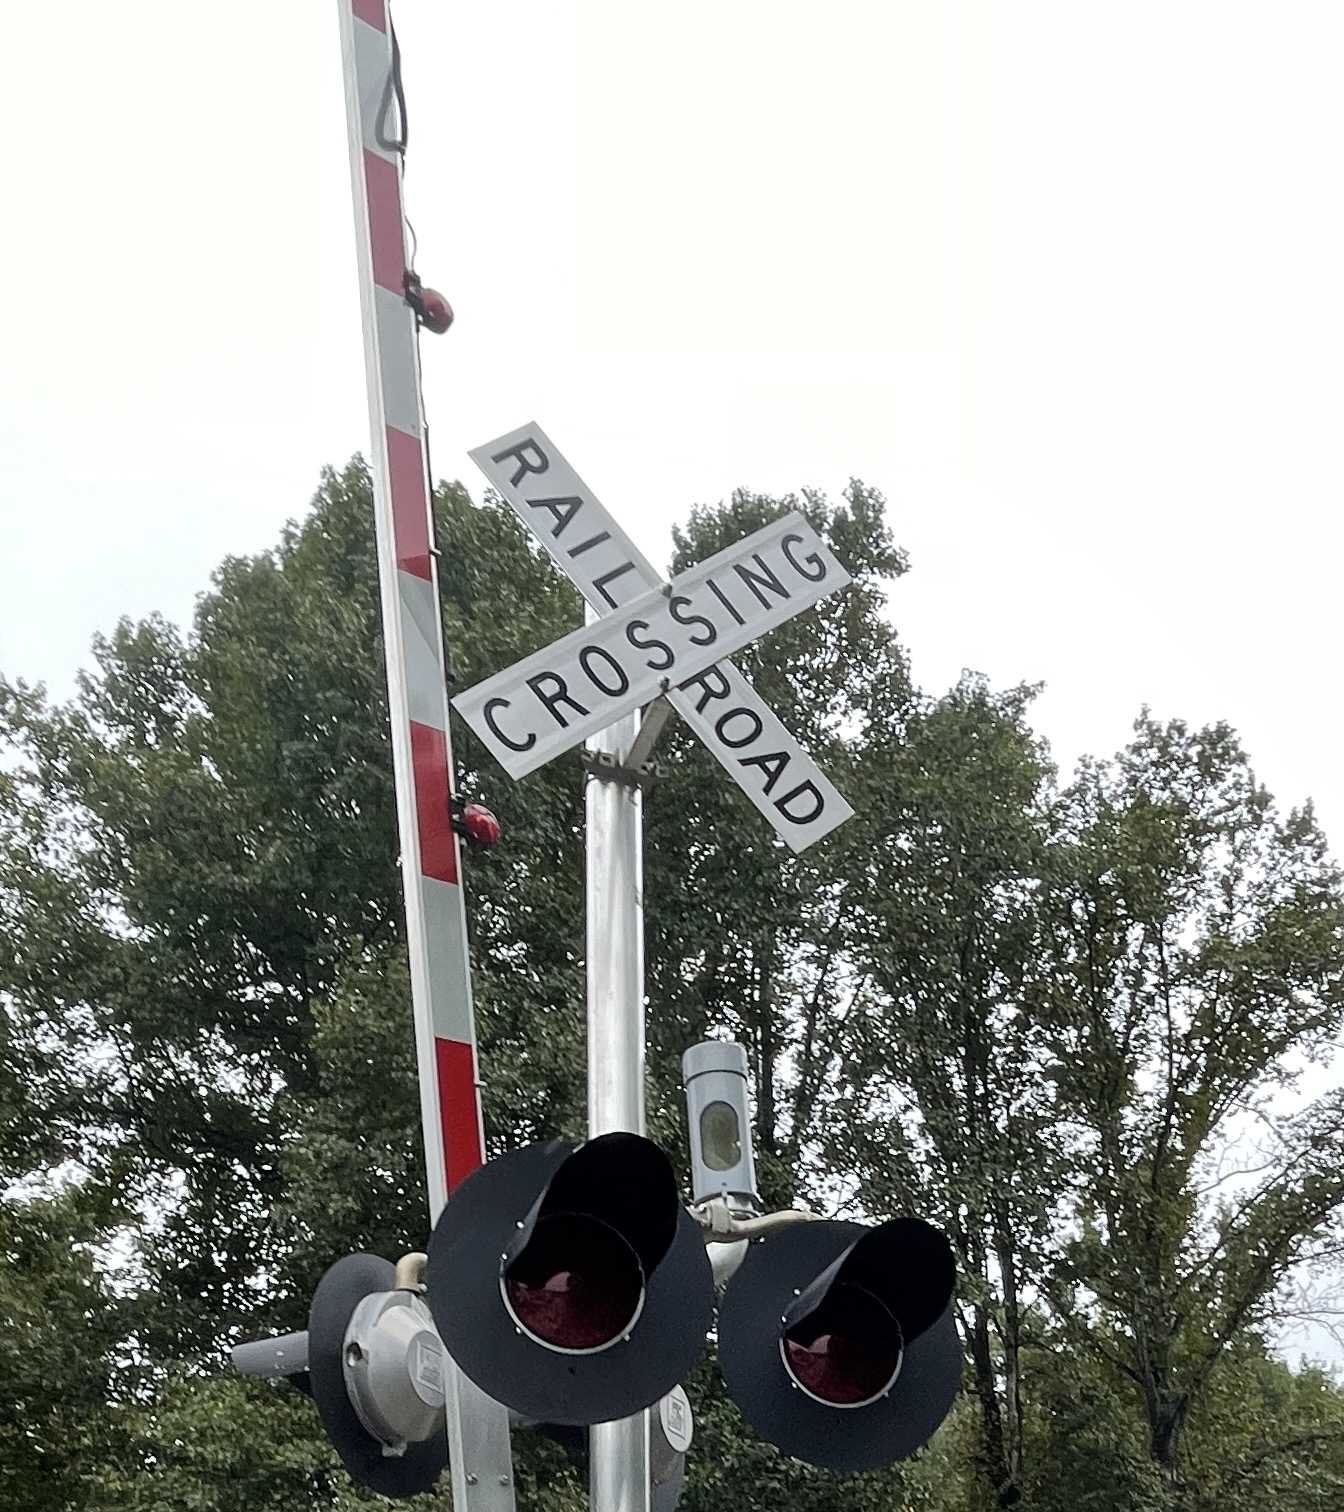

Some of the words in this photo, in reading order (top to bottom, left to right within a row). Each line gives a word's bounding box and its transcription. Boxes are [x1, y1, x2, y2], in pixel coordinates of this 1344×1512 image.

[483, 533, 827, 753] CROSSING
[490, 437, 636, 610] RAIL
[678, 664, 825, 825] ROAD
